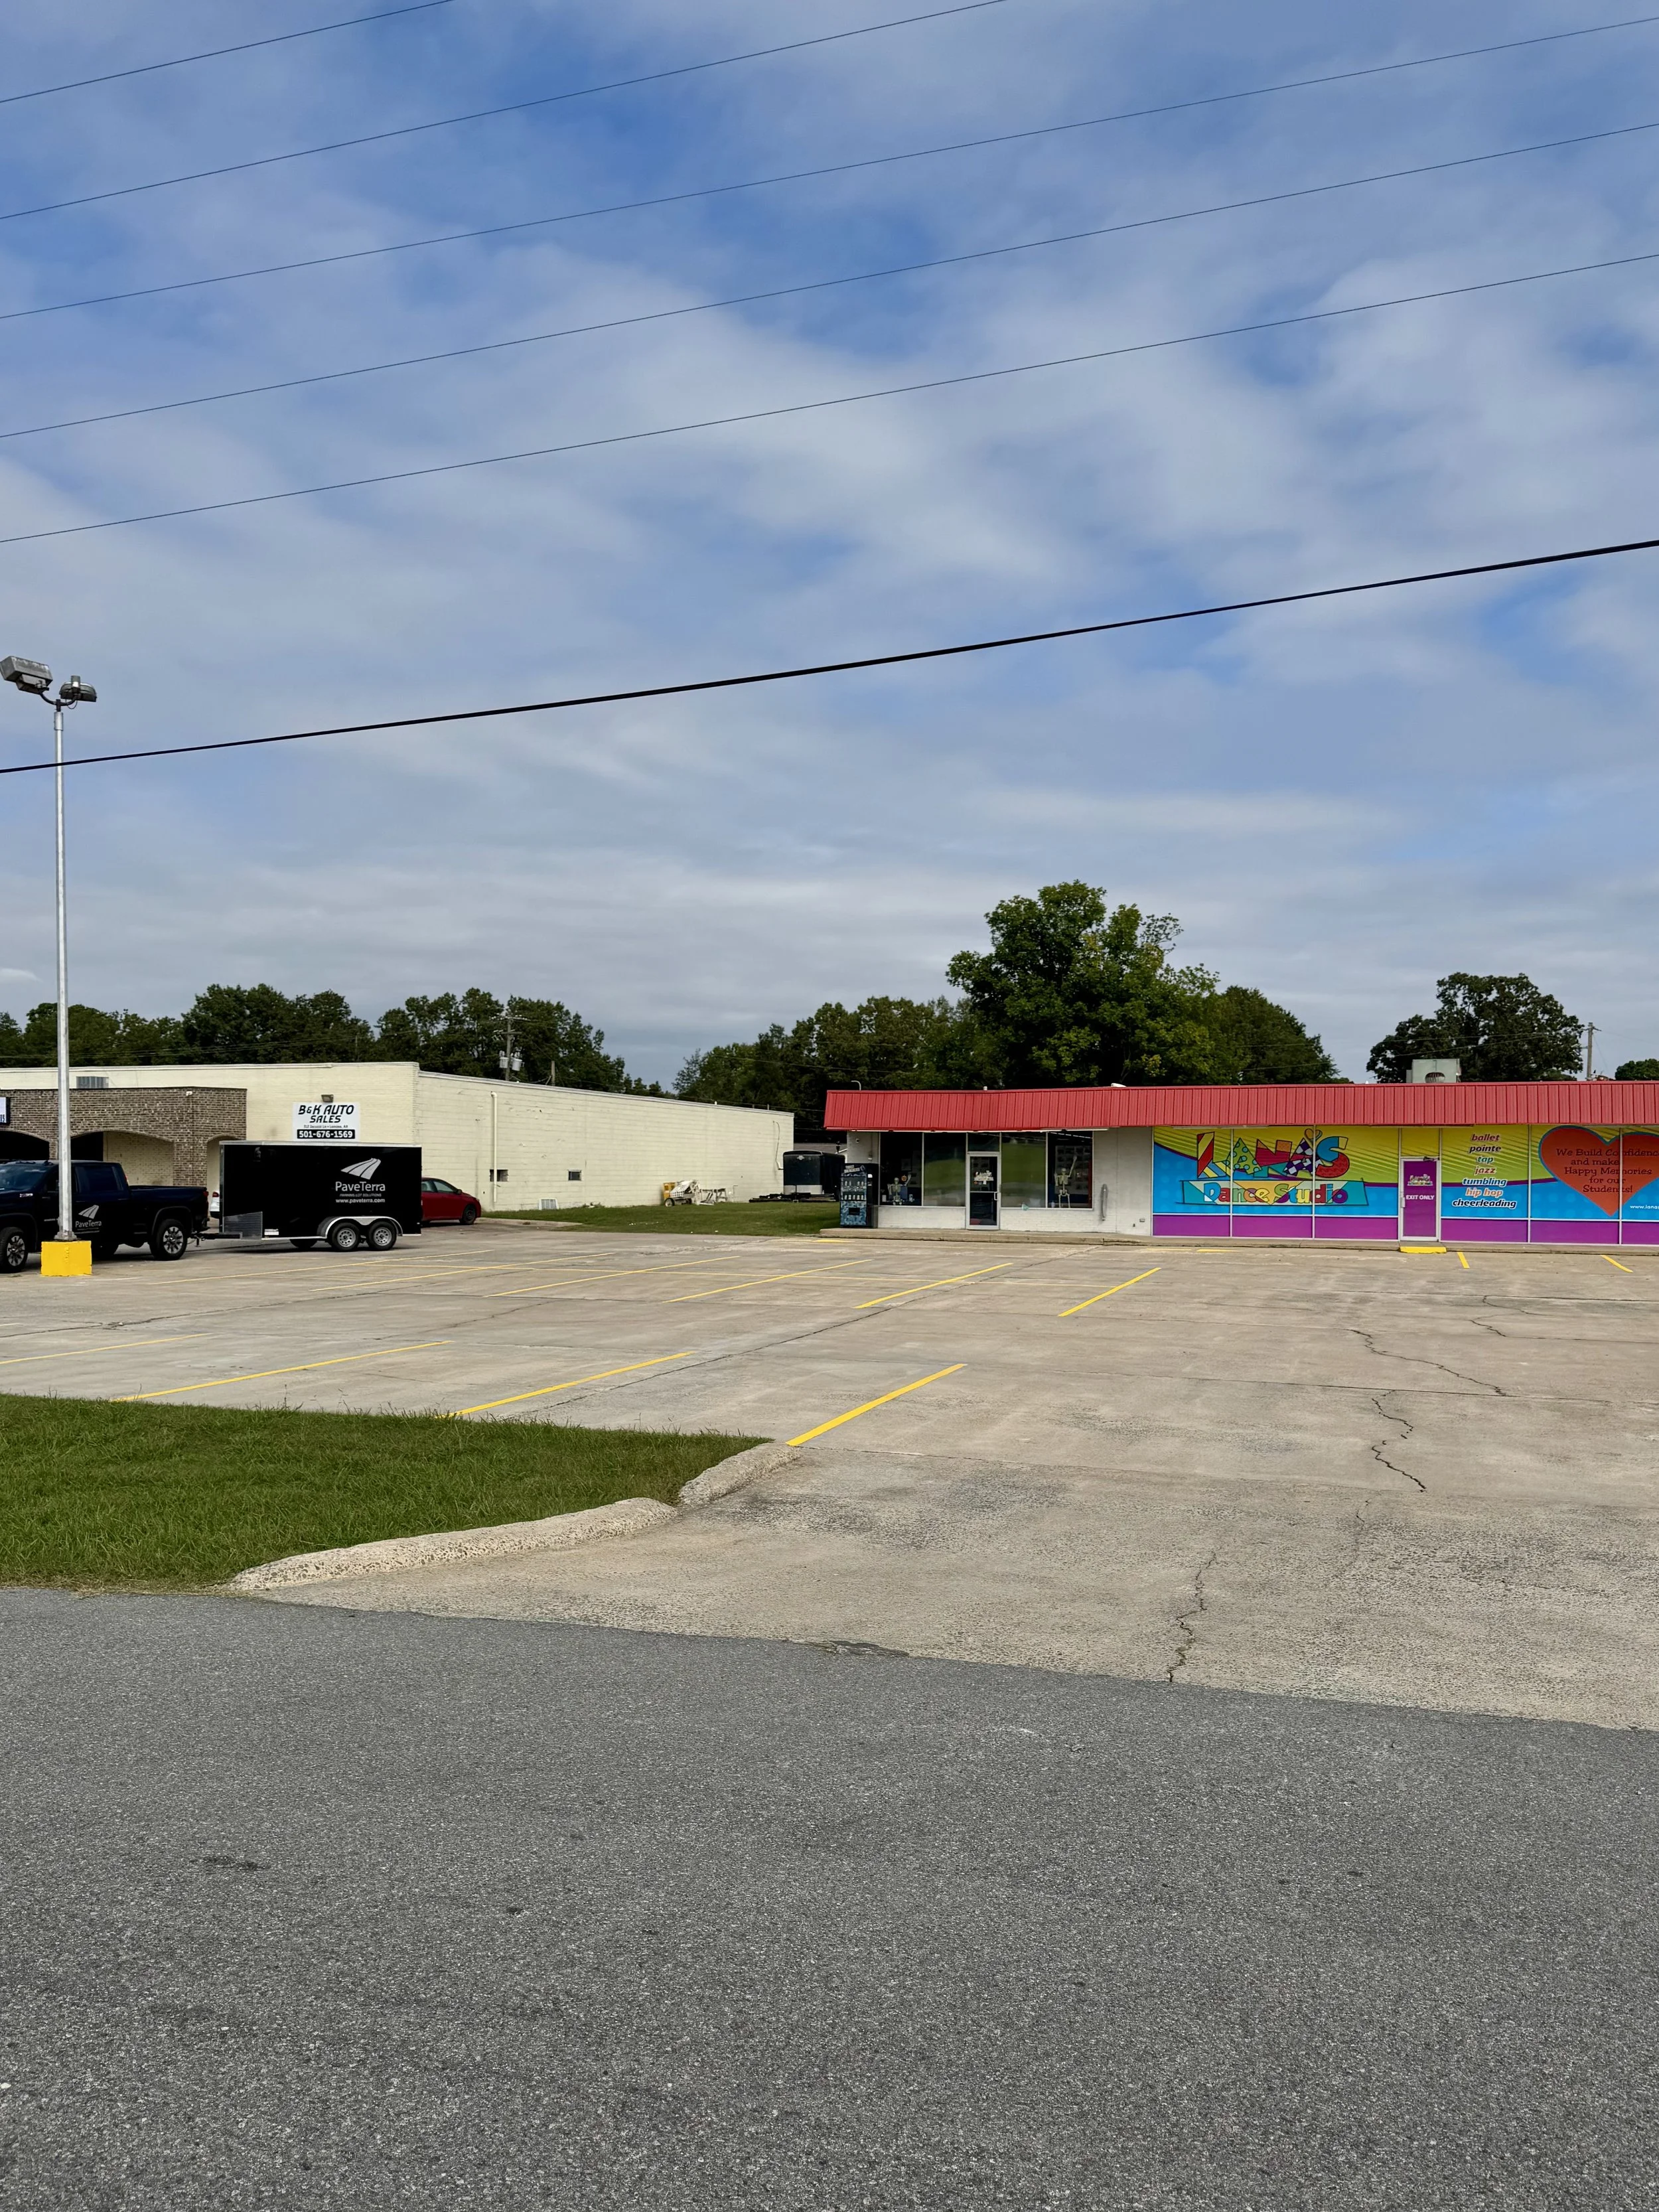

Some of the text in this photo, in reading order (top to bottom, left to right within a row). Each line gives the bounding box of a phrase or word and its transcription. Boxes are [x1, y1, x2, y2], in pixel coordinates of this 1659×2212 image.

[298, 1105, 354, 1115] B&K AUTO
[1469, 1145, 1502, 1153] pointe
[1475, 1166, 1496, 1175] jazz
[1565, 1167, 1597, 1175] Happy
[335, 1181, 386, 1191] PaveTerra
[1463, 1177, 1507, 1187] tumbling
[1203, 1182, 1348, 1204] Dance Studio
[1466, 1188, 1502, 1197] hip hop
[1453, 1199, 1517, 1209] cheerleading
